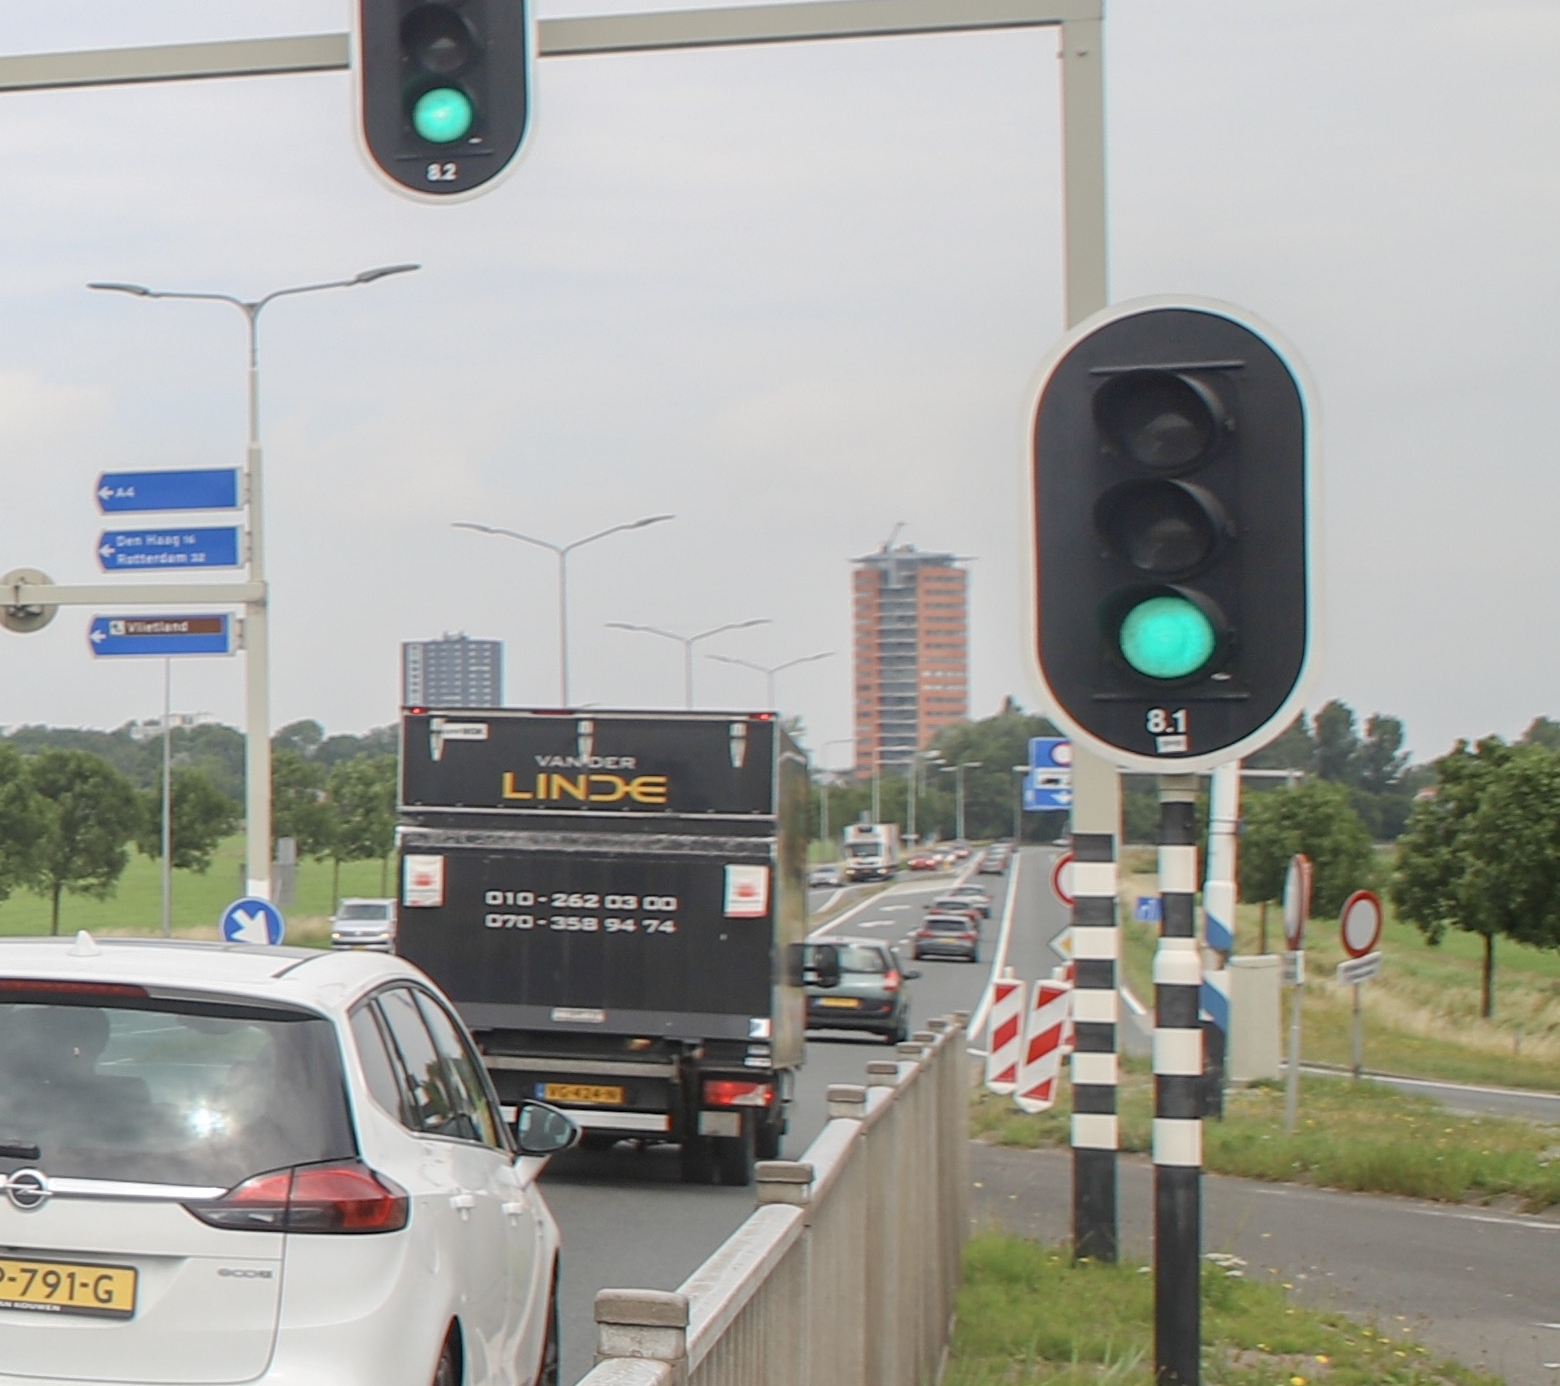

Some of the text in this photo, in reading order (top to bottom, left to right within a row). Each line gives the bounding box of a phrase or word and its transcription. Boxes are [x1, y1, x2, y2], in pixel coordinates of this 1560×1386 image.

[426, 162, 457, 181] 8.2
[115, 486, 135, 498] A4
[116, 535, 142, 546] Den
[146, 534, 180, 548] Haag
[116, 553, 188, 564] Rotterdam
[1146, 709, 1188, 733] 8.1
[535, 755, 636, 769] VAN DER
[502, 772, 667, 803] LINDE
[604, 895, 638, 910] 03
[642, 896, 677, 911] 00
[604, 917, 637, 932] 94
[642, 919, 676, 933] 74
